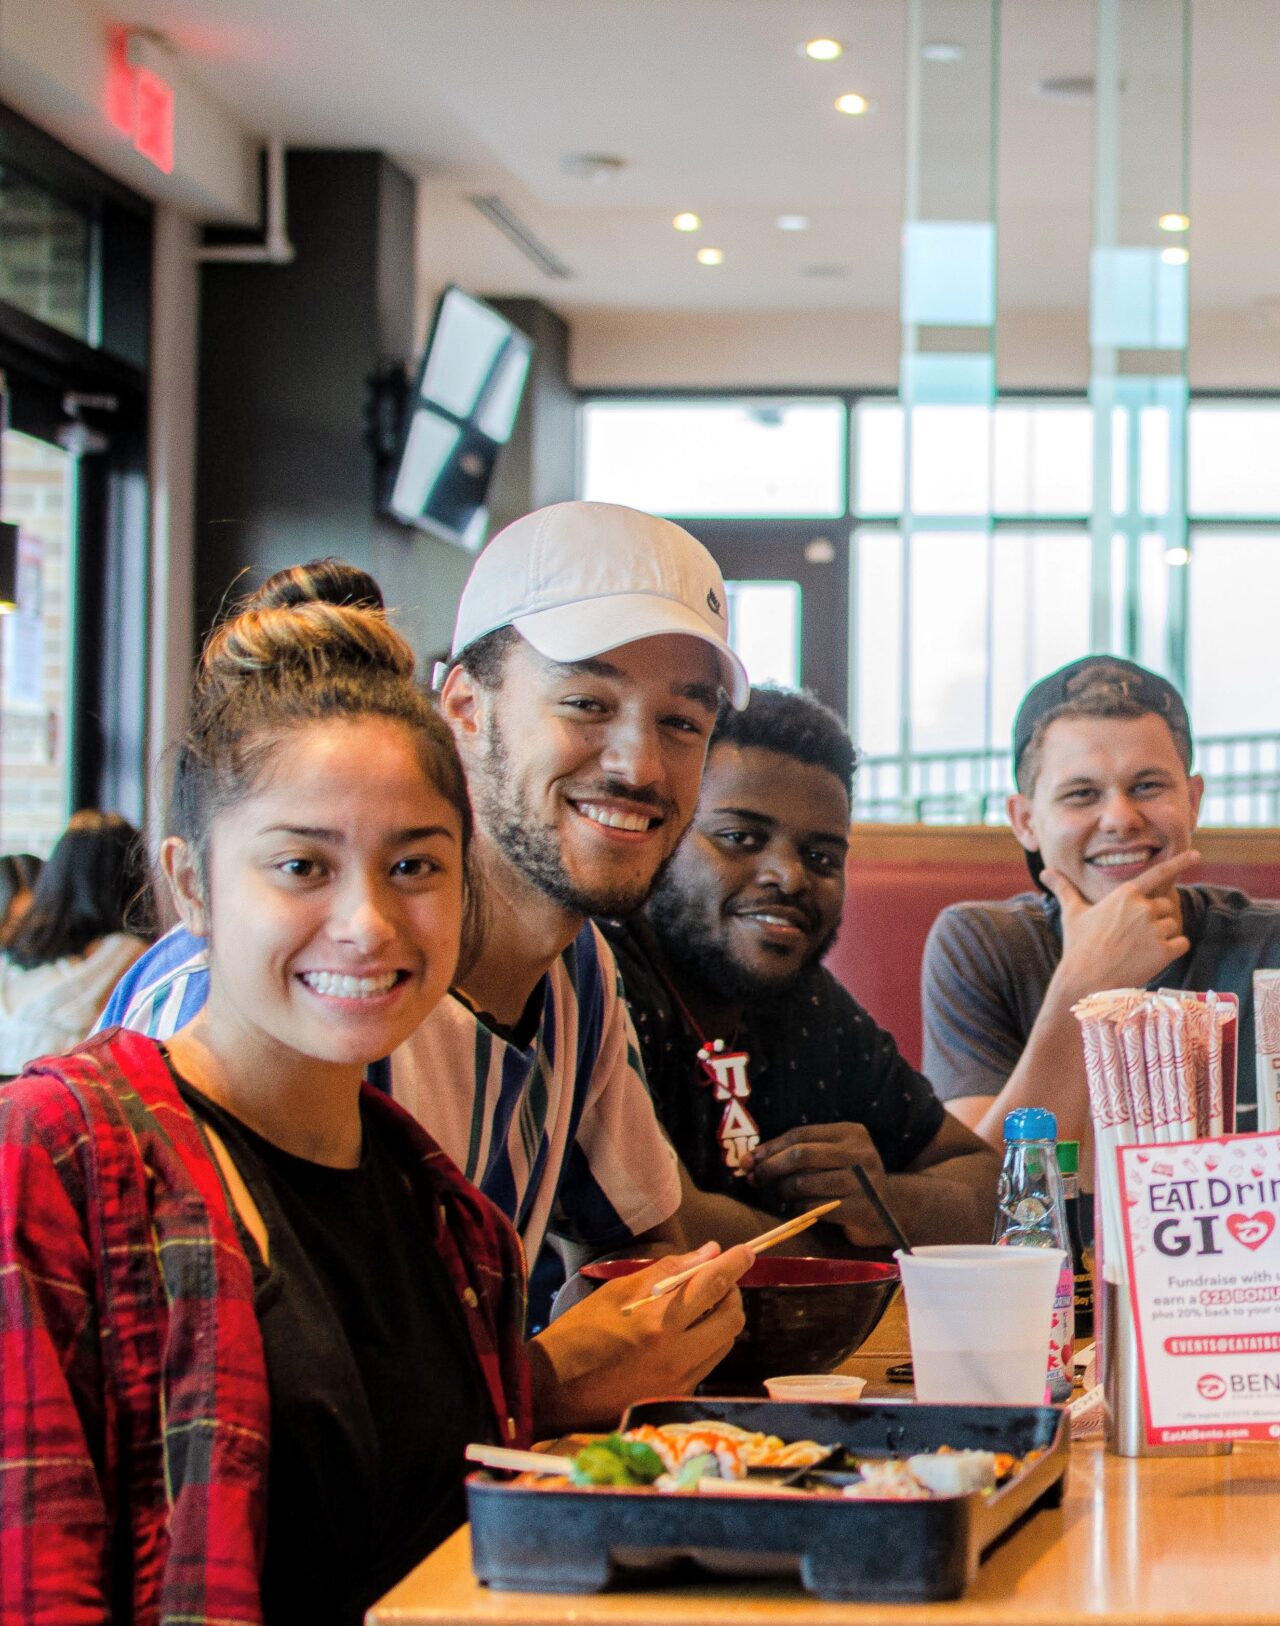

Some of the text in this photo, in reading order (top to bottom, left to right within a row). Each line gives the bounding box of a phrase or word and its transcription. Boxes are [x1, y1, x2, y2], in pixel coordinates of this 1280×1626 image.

[1149, 1180, 1204, 1212] EAT.
[1168, 1273, 1237, 1288] Fundraise
[1241, 1269, 1272, 1284] with
[1153, 1295, 1185, 1306] earn
[1189, 1294, 1197, 1304] a
[1200, 1289, 1232, 1306] $25
[1152, 1308, 1174, 1321] plus
[1178, 1306, 1201, 1318] 20%
[1205, 1303, 1230, 1317] back
[1233, 1304, 1245, 1315] to
[1248, 1302, 1271, 1316] your
